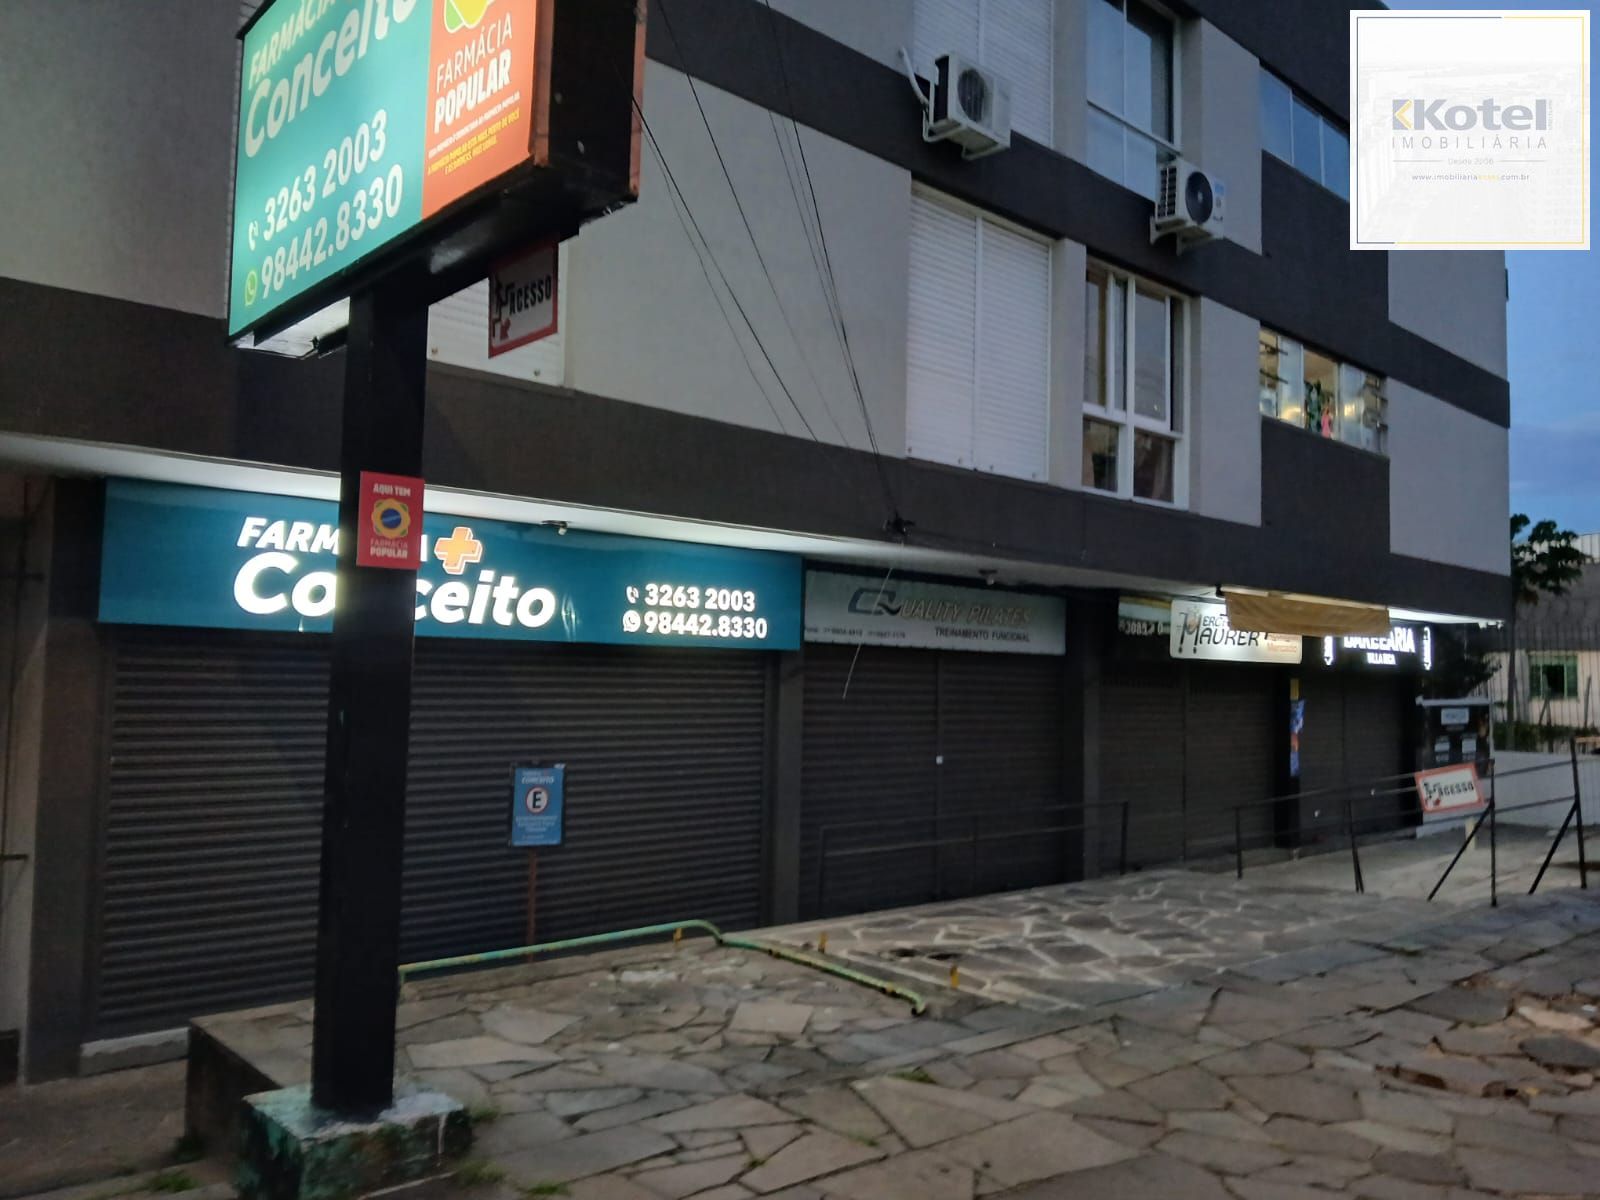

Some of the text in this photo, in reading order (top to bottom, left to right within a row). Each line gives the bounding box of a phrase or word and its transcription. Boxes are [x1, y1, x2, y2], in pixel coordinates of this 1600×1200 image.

[436, 12, 513, 93] FARMÁCIA
[434, 49, 512, 134] POPULAR
[263, 165, 316, 241] 3263
[322, 109, 387, 199] 2003
[261, 164, 403, 299] 98442.8330
[373, 483, 411, 497] AQUI TEM
[370, 546, 408, 559] POPULAR
[233, 551, 556, 628] Coceito
[644, 583, 755, 612] 3263 2003
[644, 610, 768, 639] 98442.8330
[531, 791, 543, 809] E
